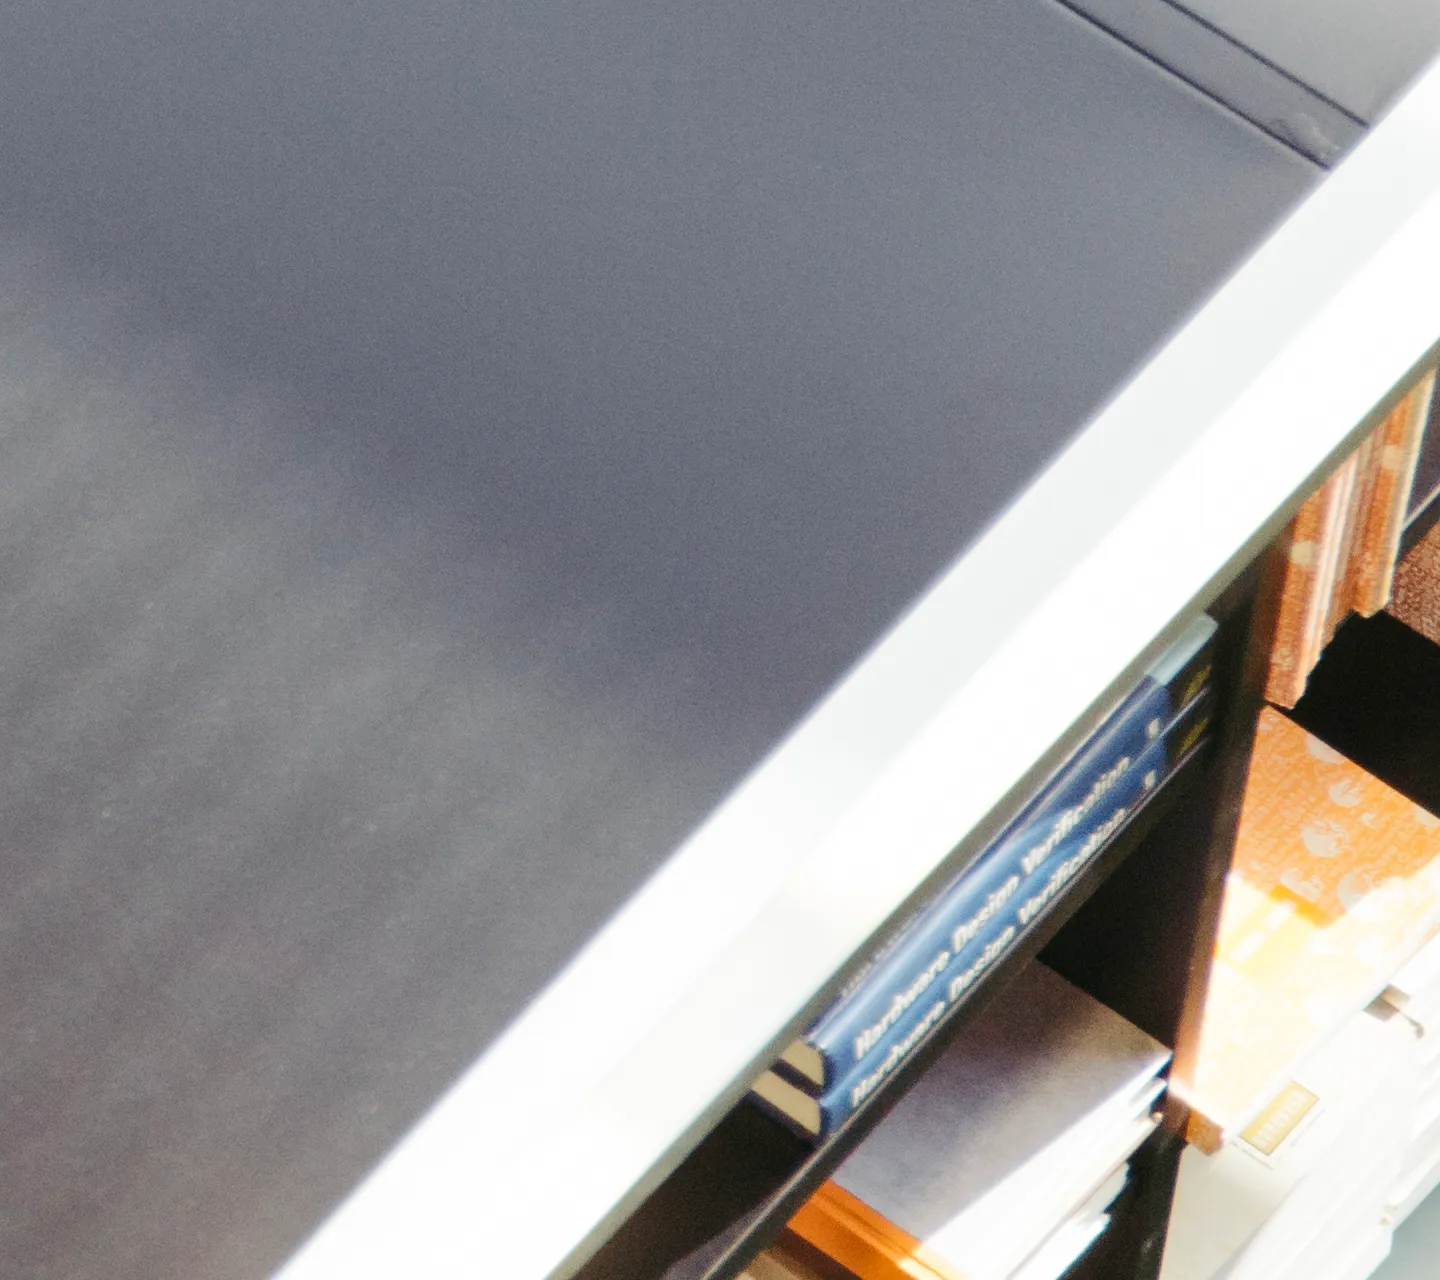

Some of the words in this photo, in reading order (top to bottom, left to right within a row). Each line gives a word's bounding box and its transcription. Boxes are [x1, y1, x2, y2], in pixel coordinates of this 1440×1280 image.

[852, 1001, 945, 1106] Hardware
[949, 926, 1014, 1001] Design
[1019, 807, 1126, 925] Verification
[854, 951, 951, 1059] Hardware
[951, 876, 1019, 952] Design
[1021, 757, 1130, 876] Verification
